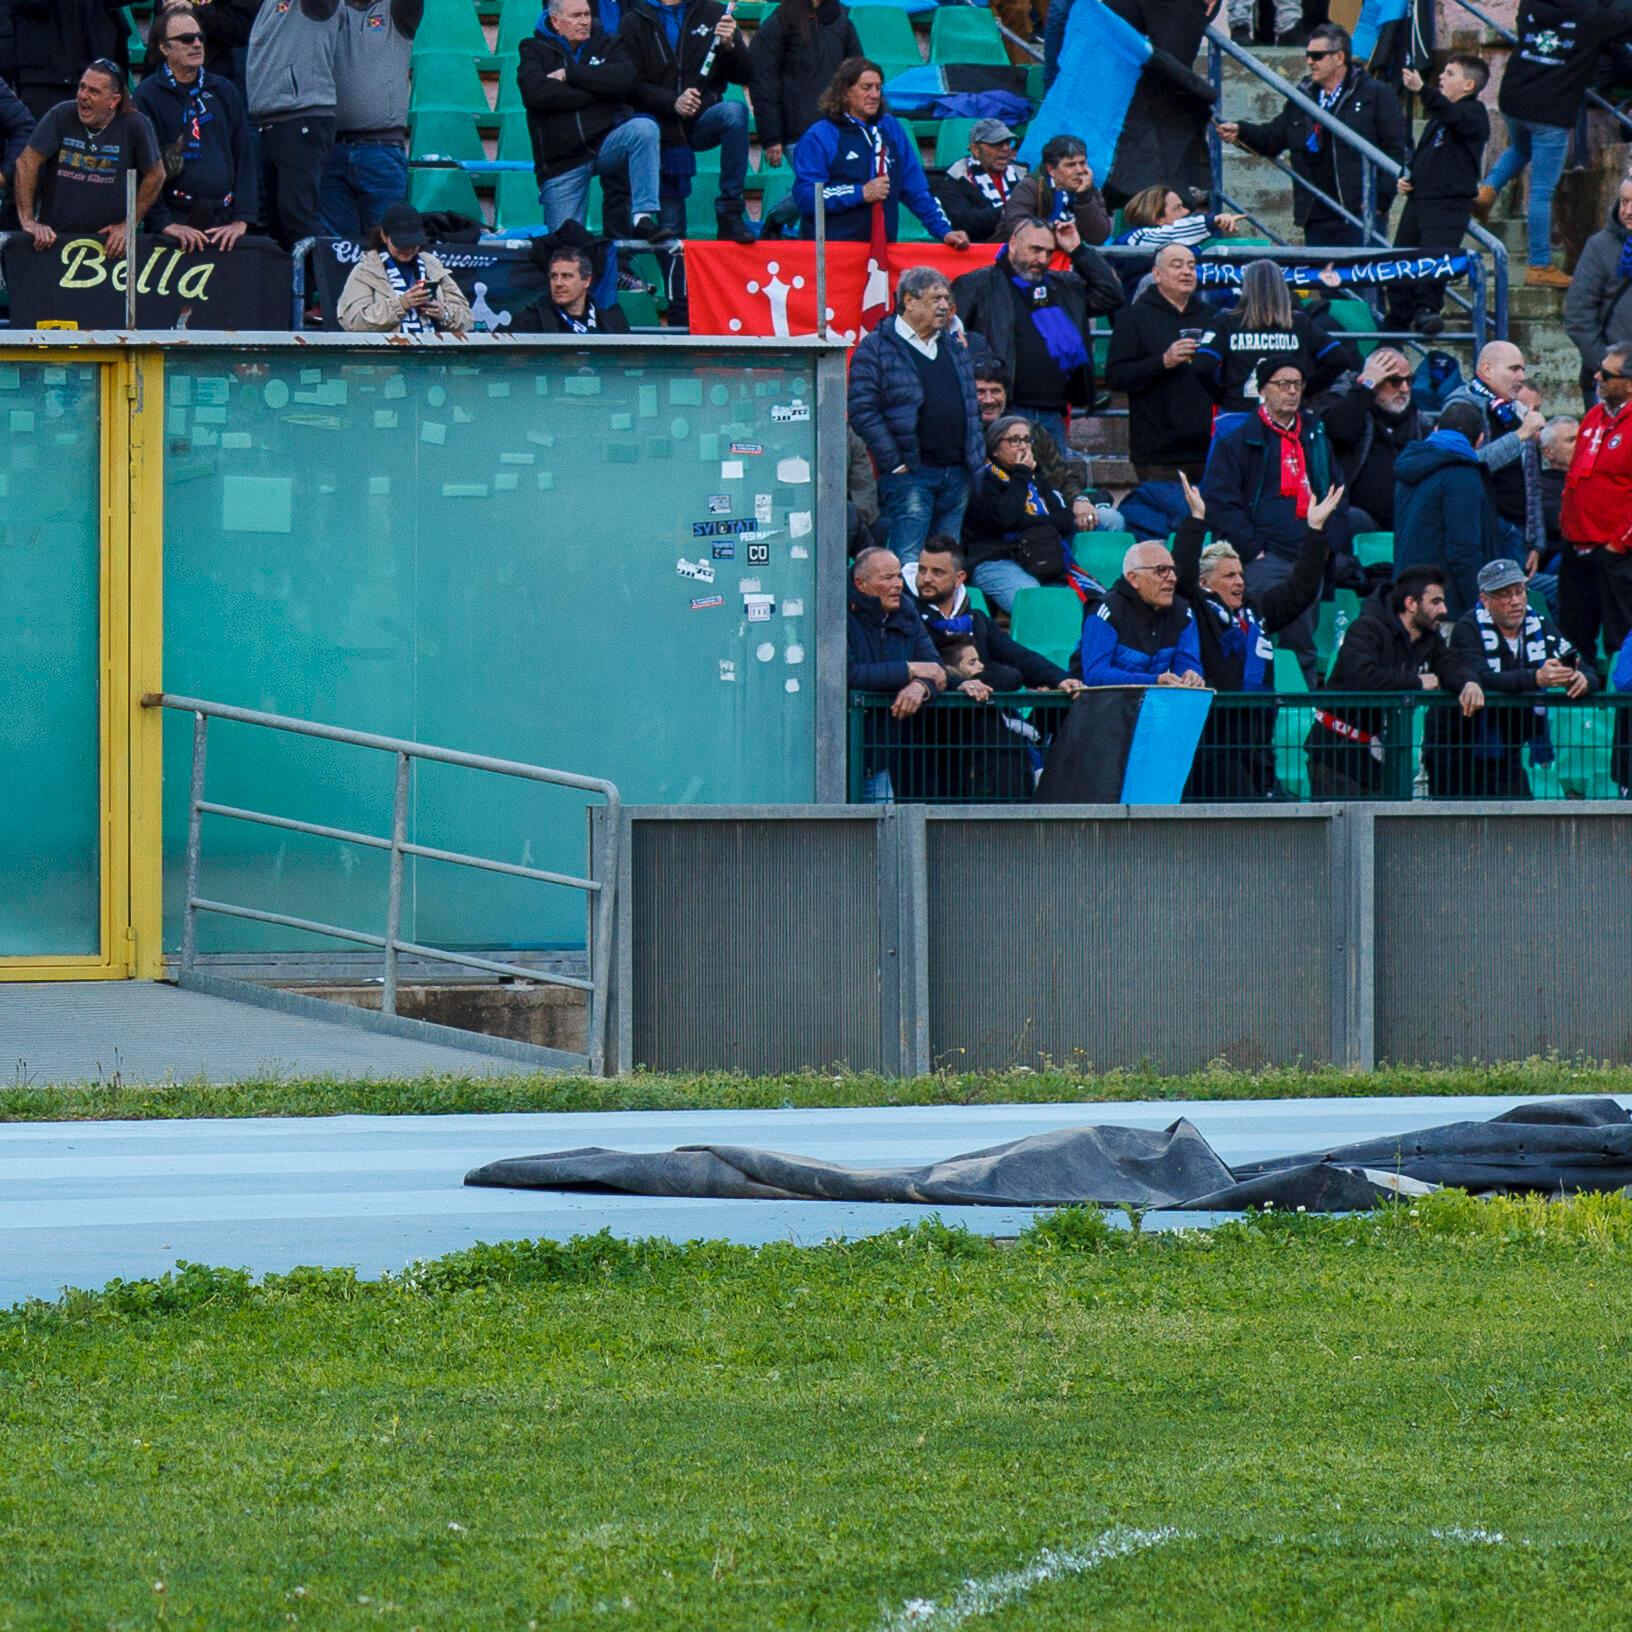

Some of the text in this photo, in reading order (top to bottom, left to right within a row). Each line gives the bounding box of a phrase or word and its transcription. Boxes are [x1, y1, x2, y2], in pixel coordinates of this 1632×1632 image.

[58, 238, 216, 301] Bella
[1350, 252, 1456, 283] MERDA
[1229, 332, 1299, 351] CARACCIOLO
